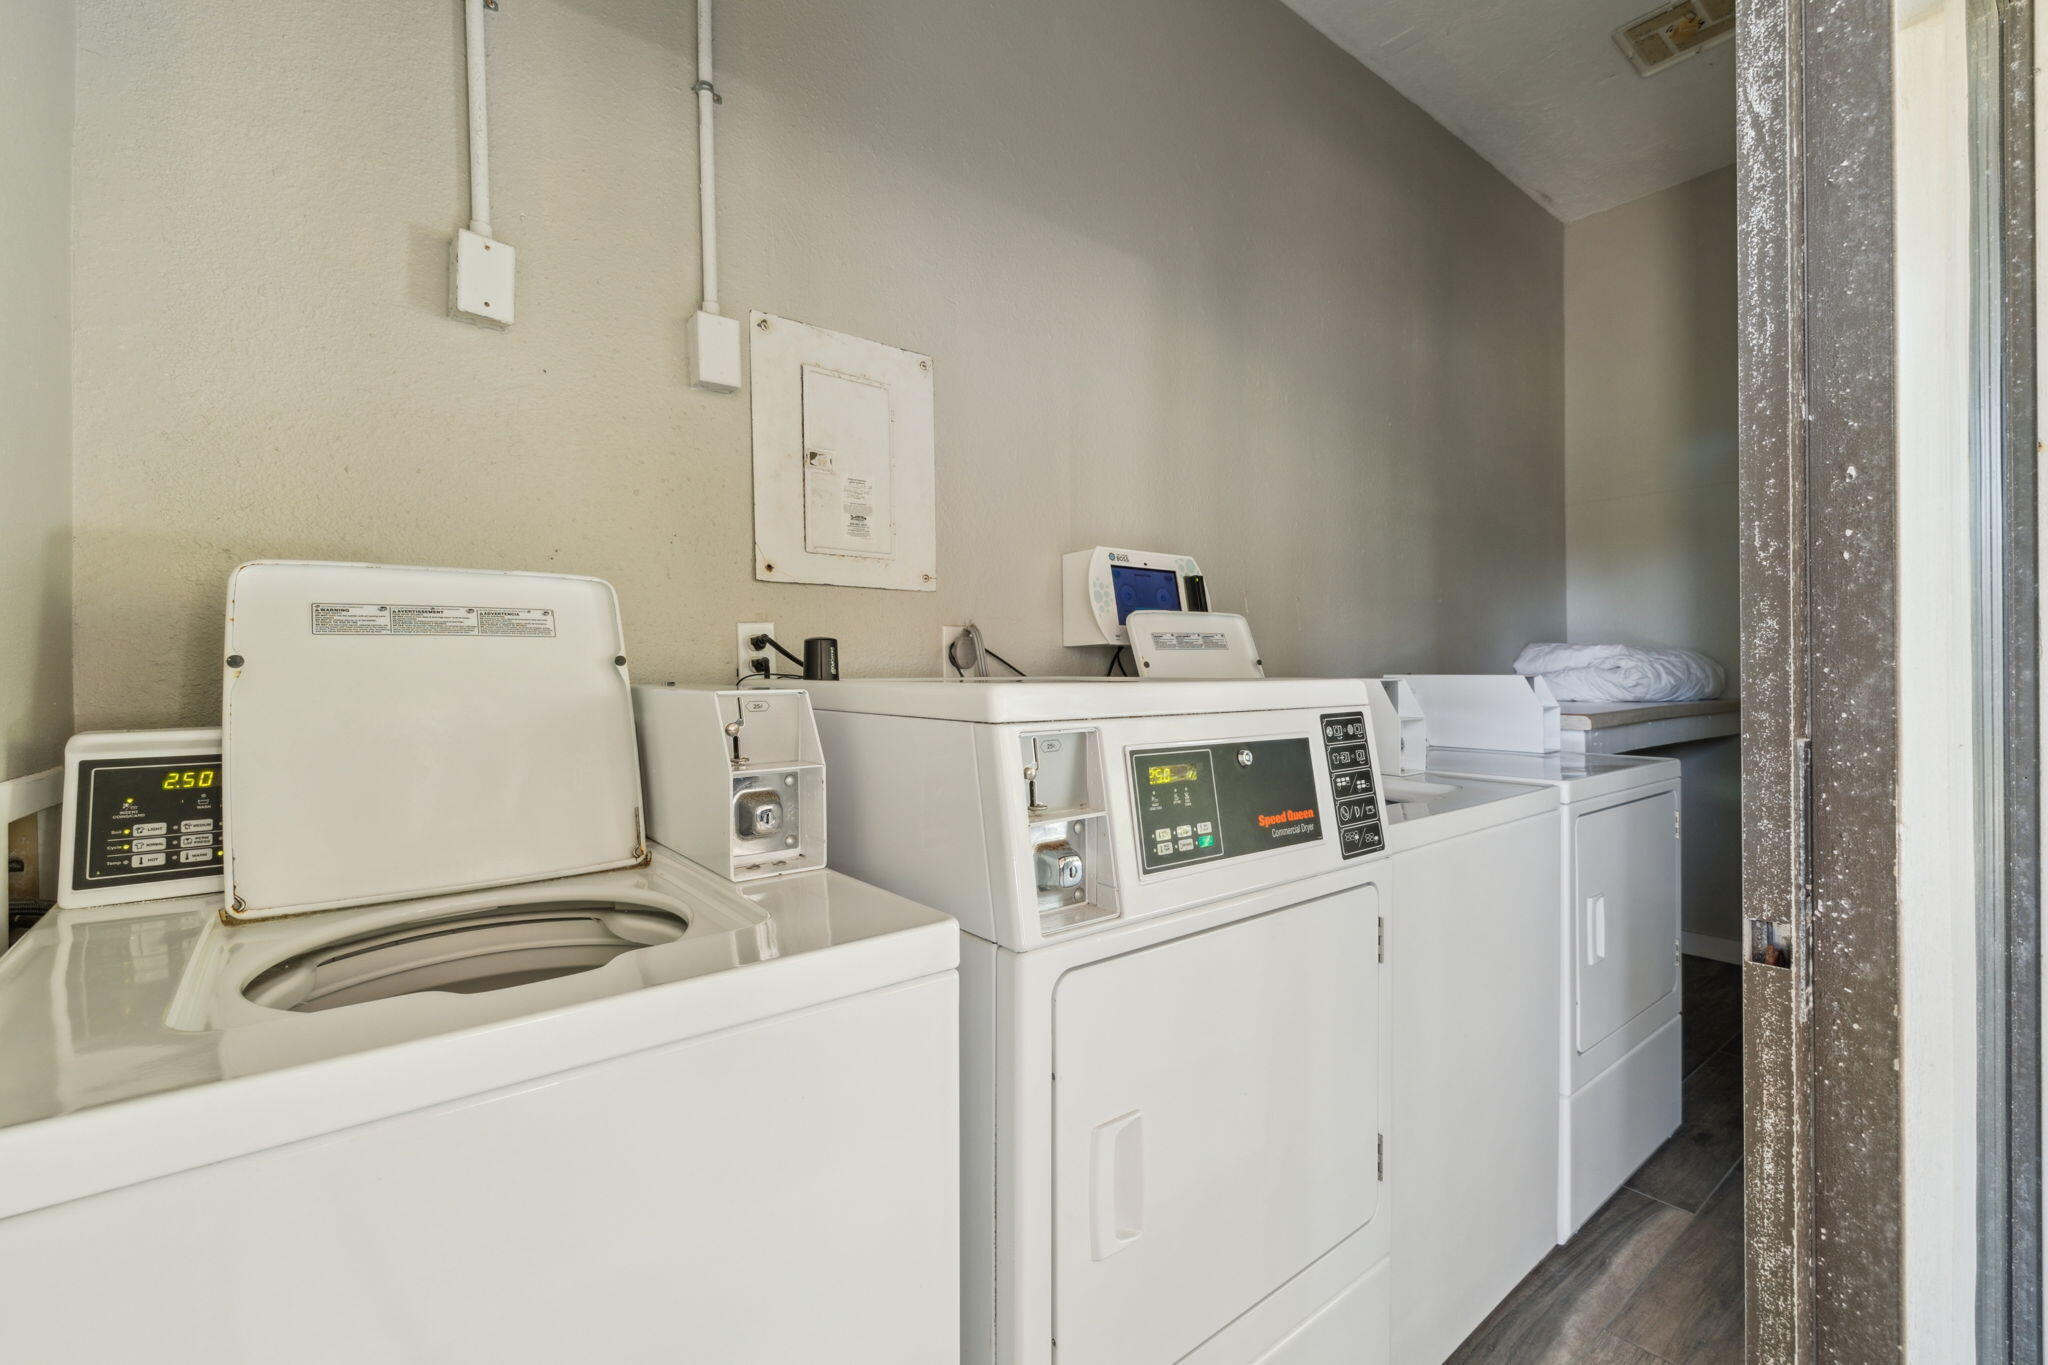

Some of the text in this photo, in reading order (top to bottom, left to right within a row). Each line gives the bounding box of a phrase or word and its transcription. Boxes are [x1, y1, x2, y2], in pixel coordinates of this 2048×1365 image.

[163, 770, 214, 789] 2.50
[1258, 809, 1315, 827] Speed Queen
[1271, 823, 1315, 838] Commercial Dryer
